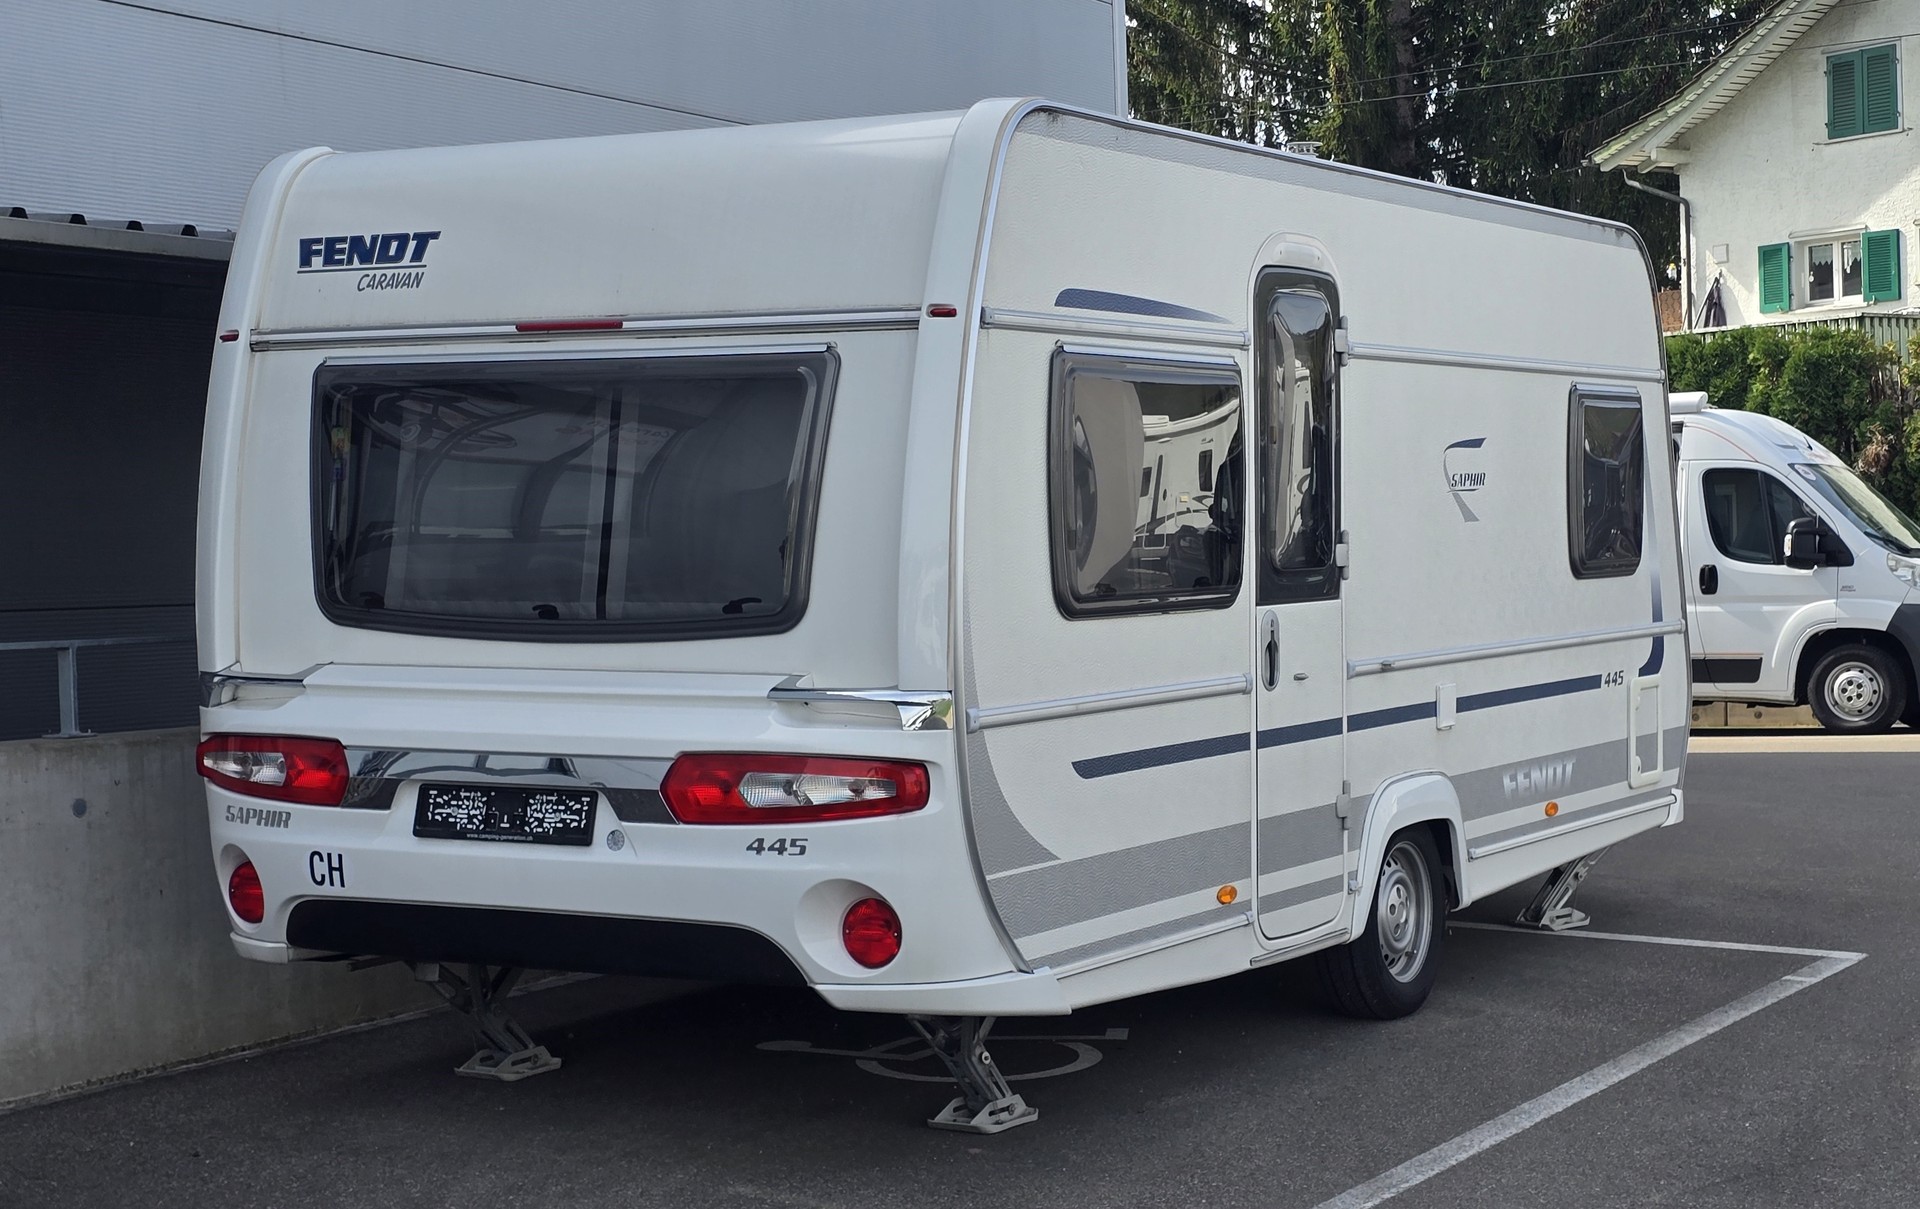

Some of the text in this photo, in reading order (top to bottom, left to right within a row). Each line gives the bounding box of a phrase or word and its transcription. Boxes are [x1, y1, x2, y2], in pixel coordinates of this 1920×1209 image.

[299, 231, 441, 268] FENDT
[357, 272, 424, 292] CARAVAN
[1451, 472, 1486, 487] SAPHIR
[1604, 670, 1624, 687] 445
[1502, 757, 1577, 799] FENDT
[225, 805, 291, 829] SAPHIR
[746, 837, 808, 856] 445
[309, 850, 346, 888] CH
